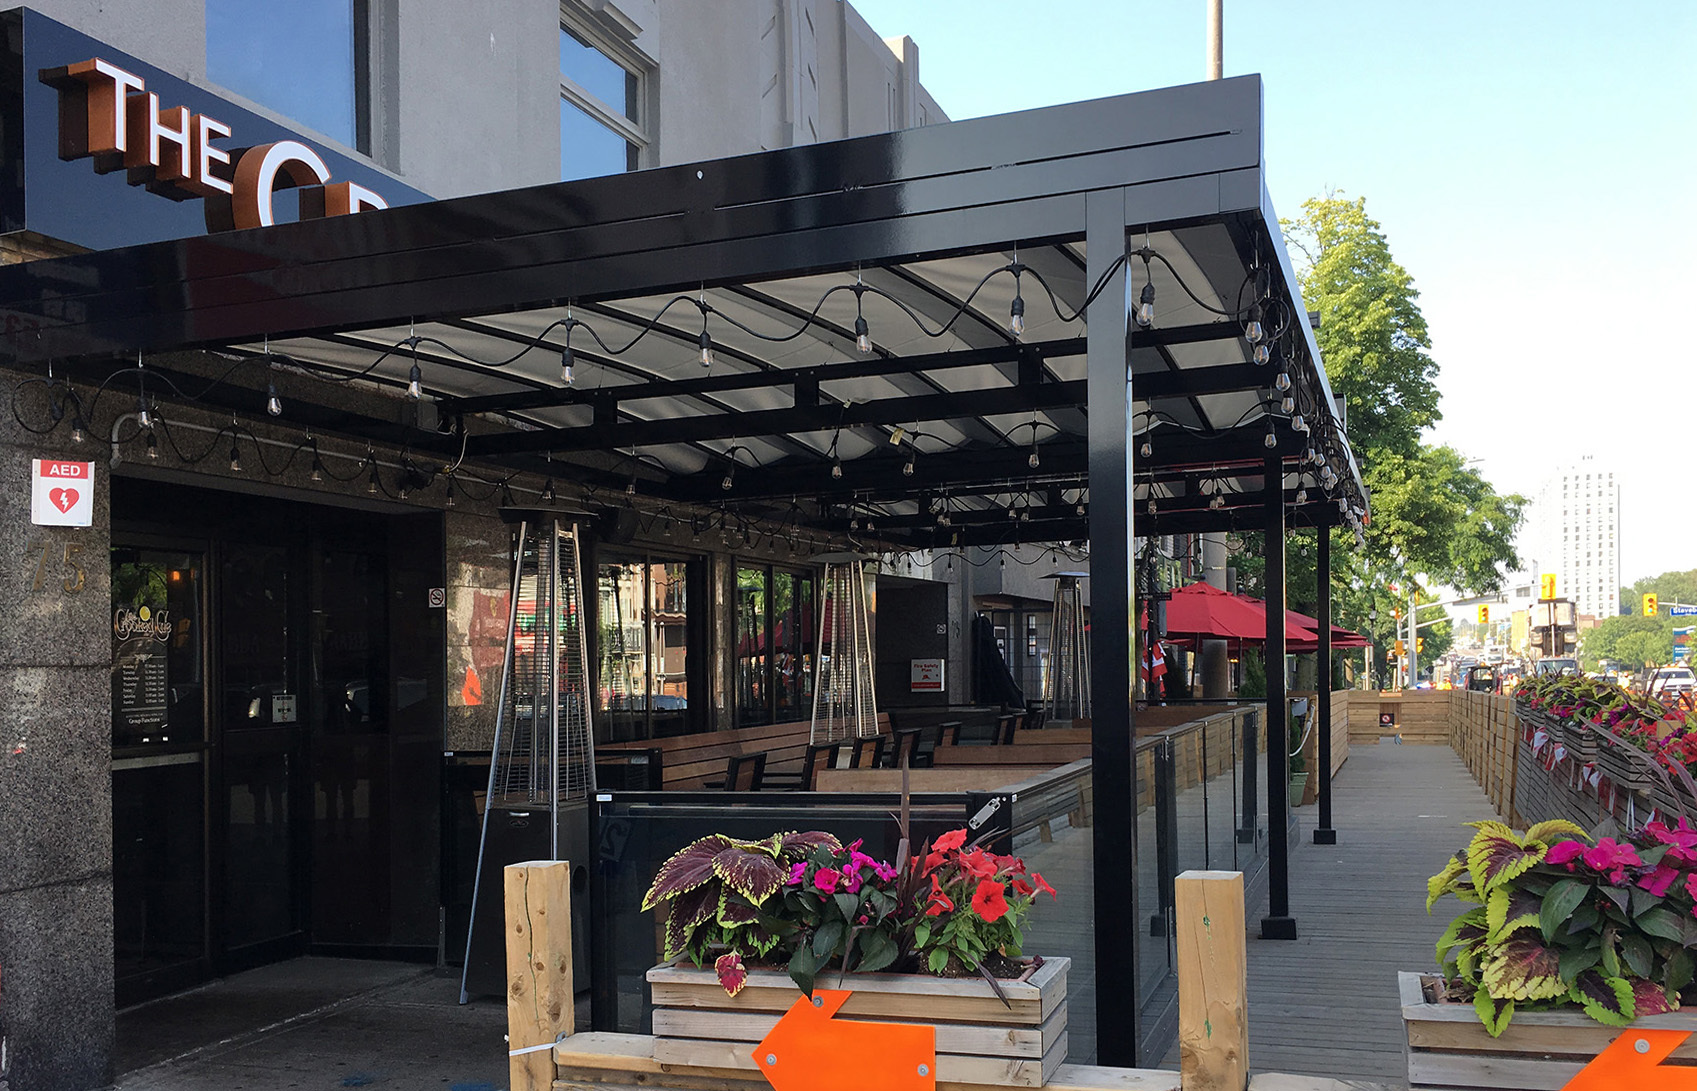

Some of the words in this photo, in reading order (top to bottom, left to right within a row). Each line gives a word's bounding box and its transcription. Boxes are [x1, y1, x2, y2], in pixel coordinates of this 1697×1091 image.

[94, 56, 234, 195] THE
[49, 463, 81, 477] AED
[24, 538, 86, 594] 75
